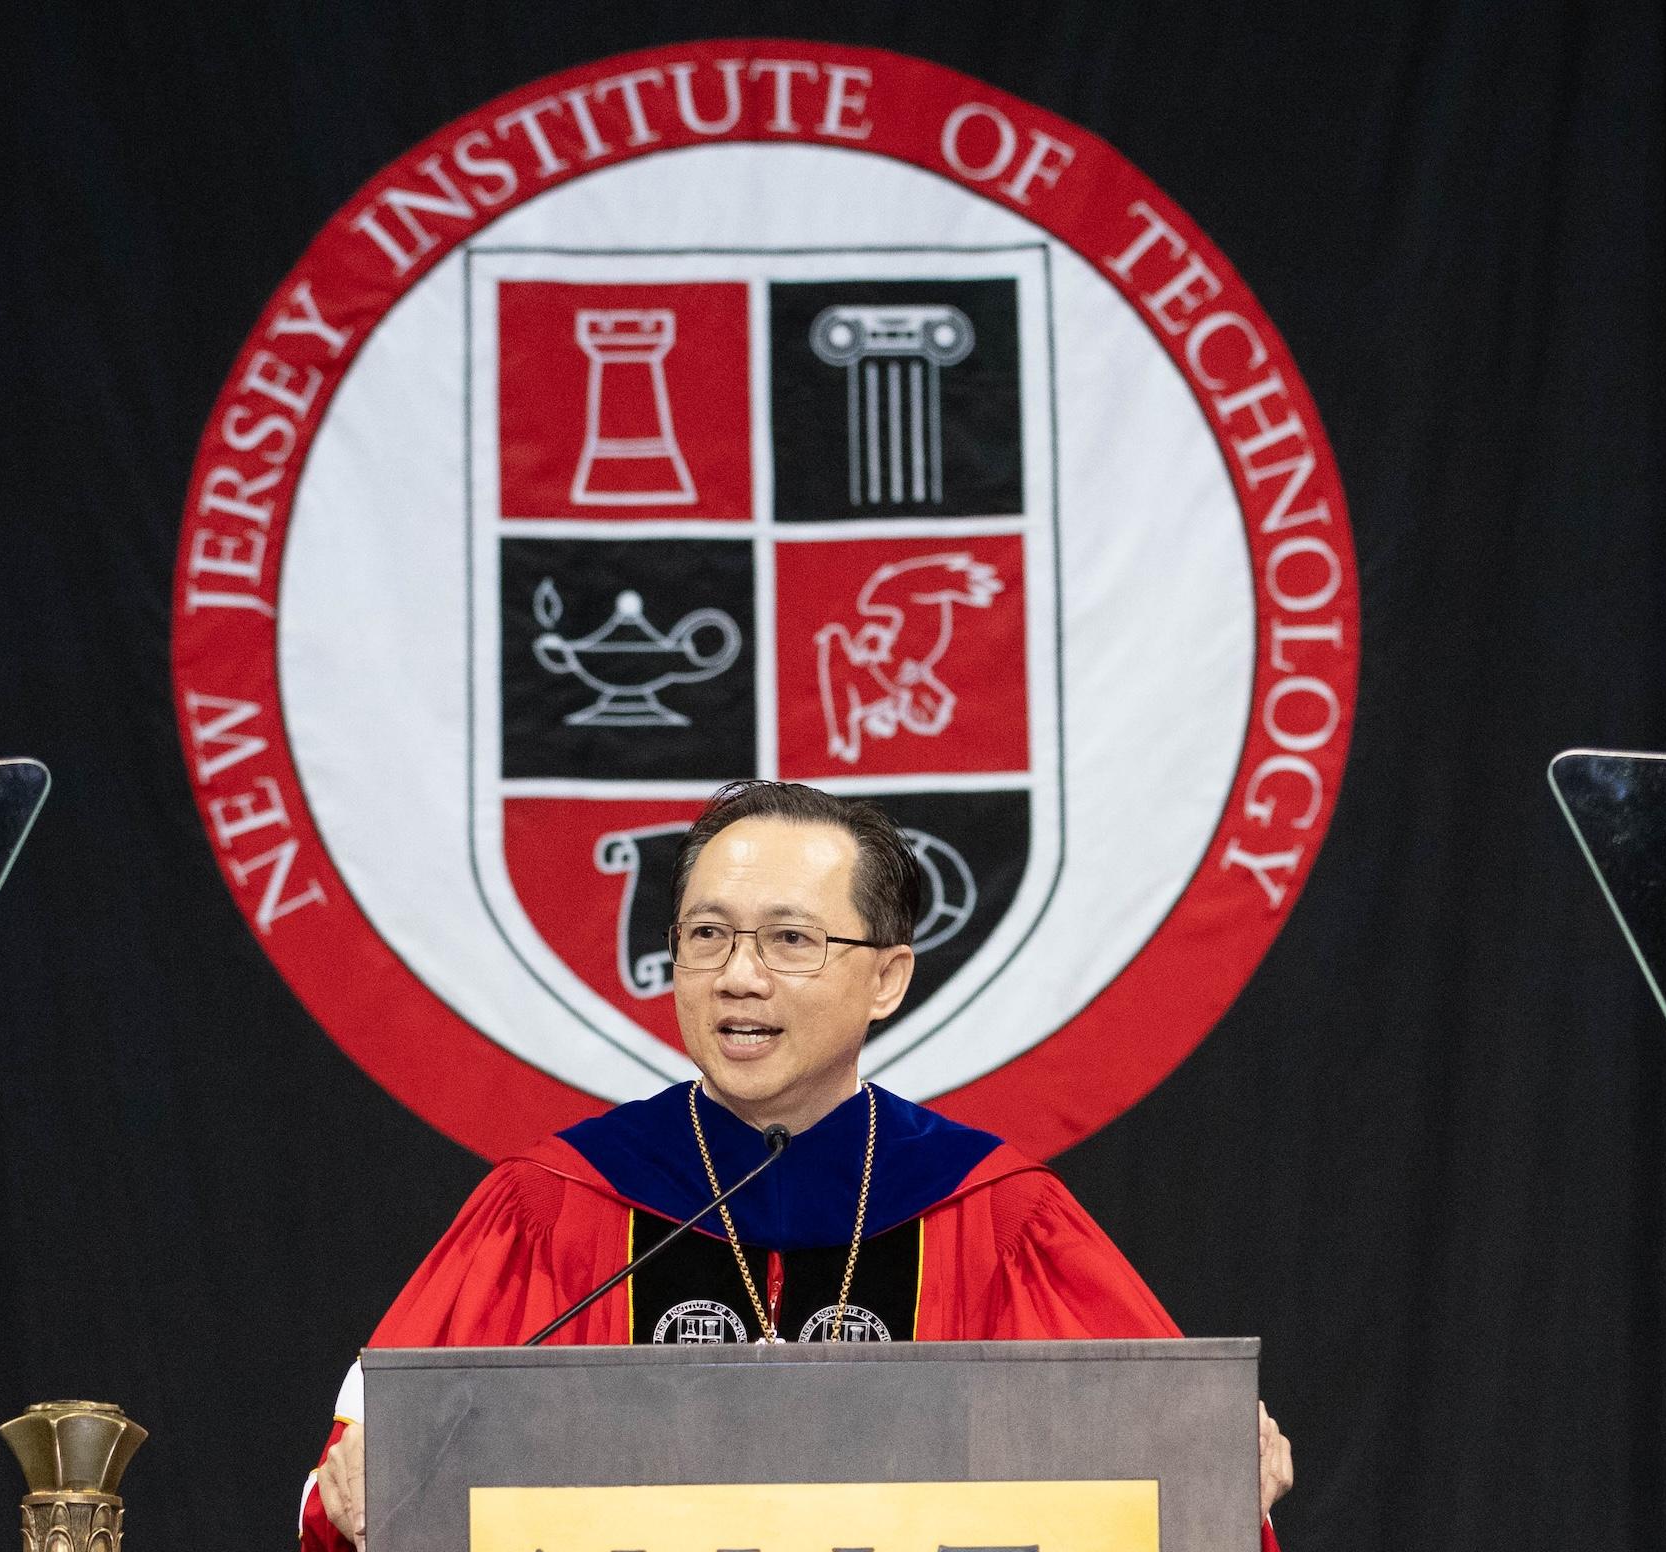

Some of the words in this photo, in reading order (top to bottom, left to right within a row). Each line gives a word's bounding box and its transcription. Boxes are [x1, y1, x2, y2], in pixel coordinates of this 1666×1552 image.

[354, 58, 873, 276] INSTITUTE
[940, 103, 1075, 205] OF
[186, 284, 350, 616] JERSEY
[1107, 201, 1344, 908] TECHNOLOGY
[186, 691, 326, 933] NEW
